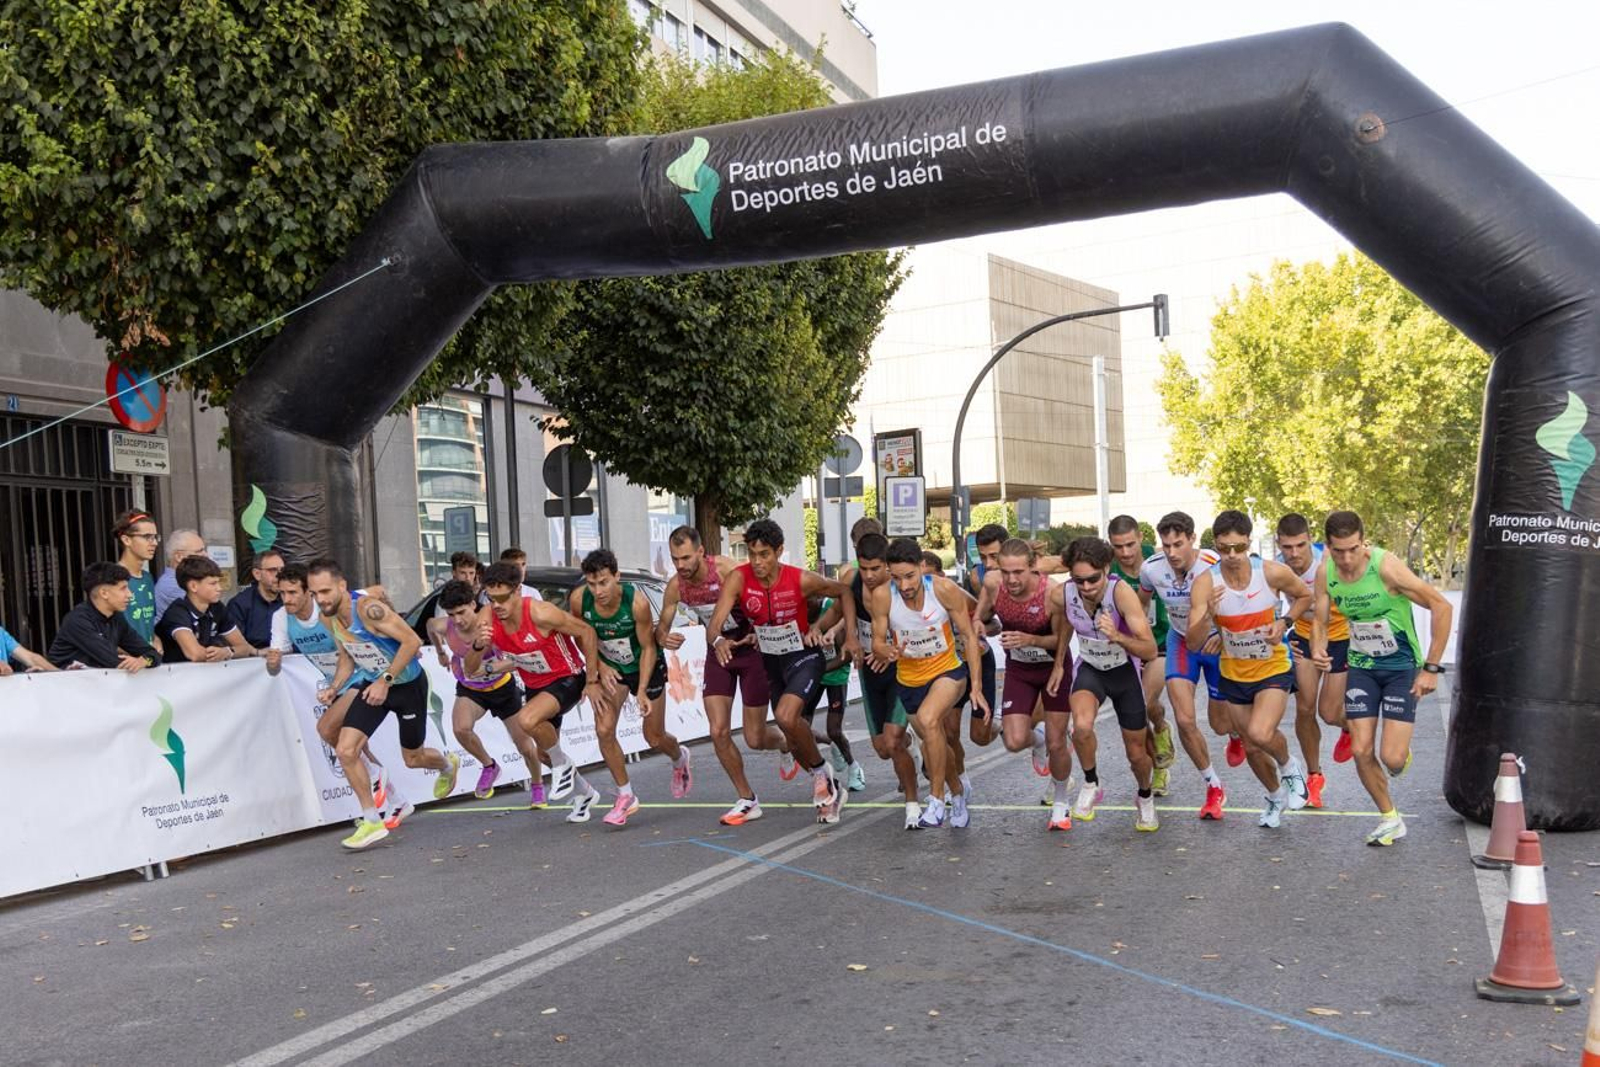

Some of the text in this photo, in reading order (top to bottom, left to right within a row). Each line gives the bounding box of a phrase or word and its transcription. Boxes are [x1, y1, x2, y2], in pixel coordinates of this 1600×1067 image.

[728, 121, 1007, 184] Patronato Municipal de
[730, 161, 943, 212] Deportes de Jaén
[899, 484, 913, 505] P
[1488, 514, 1552, 528] Patronato
[1502, 529, 1567, 545] Deportes
[1571, 533, 1590, 547] de
[294, 633, 328, 645] nerja
[1381, 640, 1394, 649] 18
[1260, 645, 1267, 653] 2
[375, 657, 387, 666] 22
[141, 793, 230, 818] Patronato Municipal de
[156, 807, 225, 830] Deportes de Jaén
